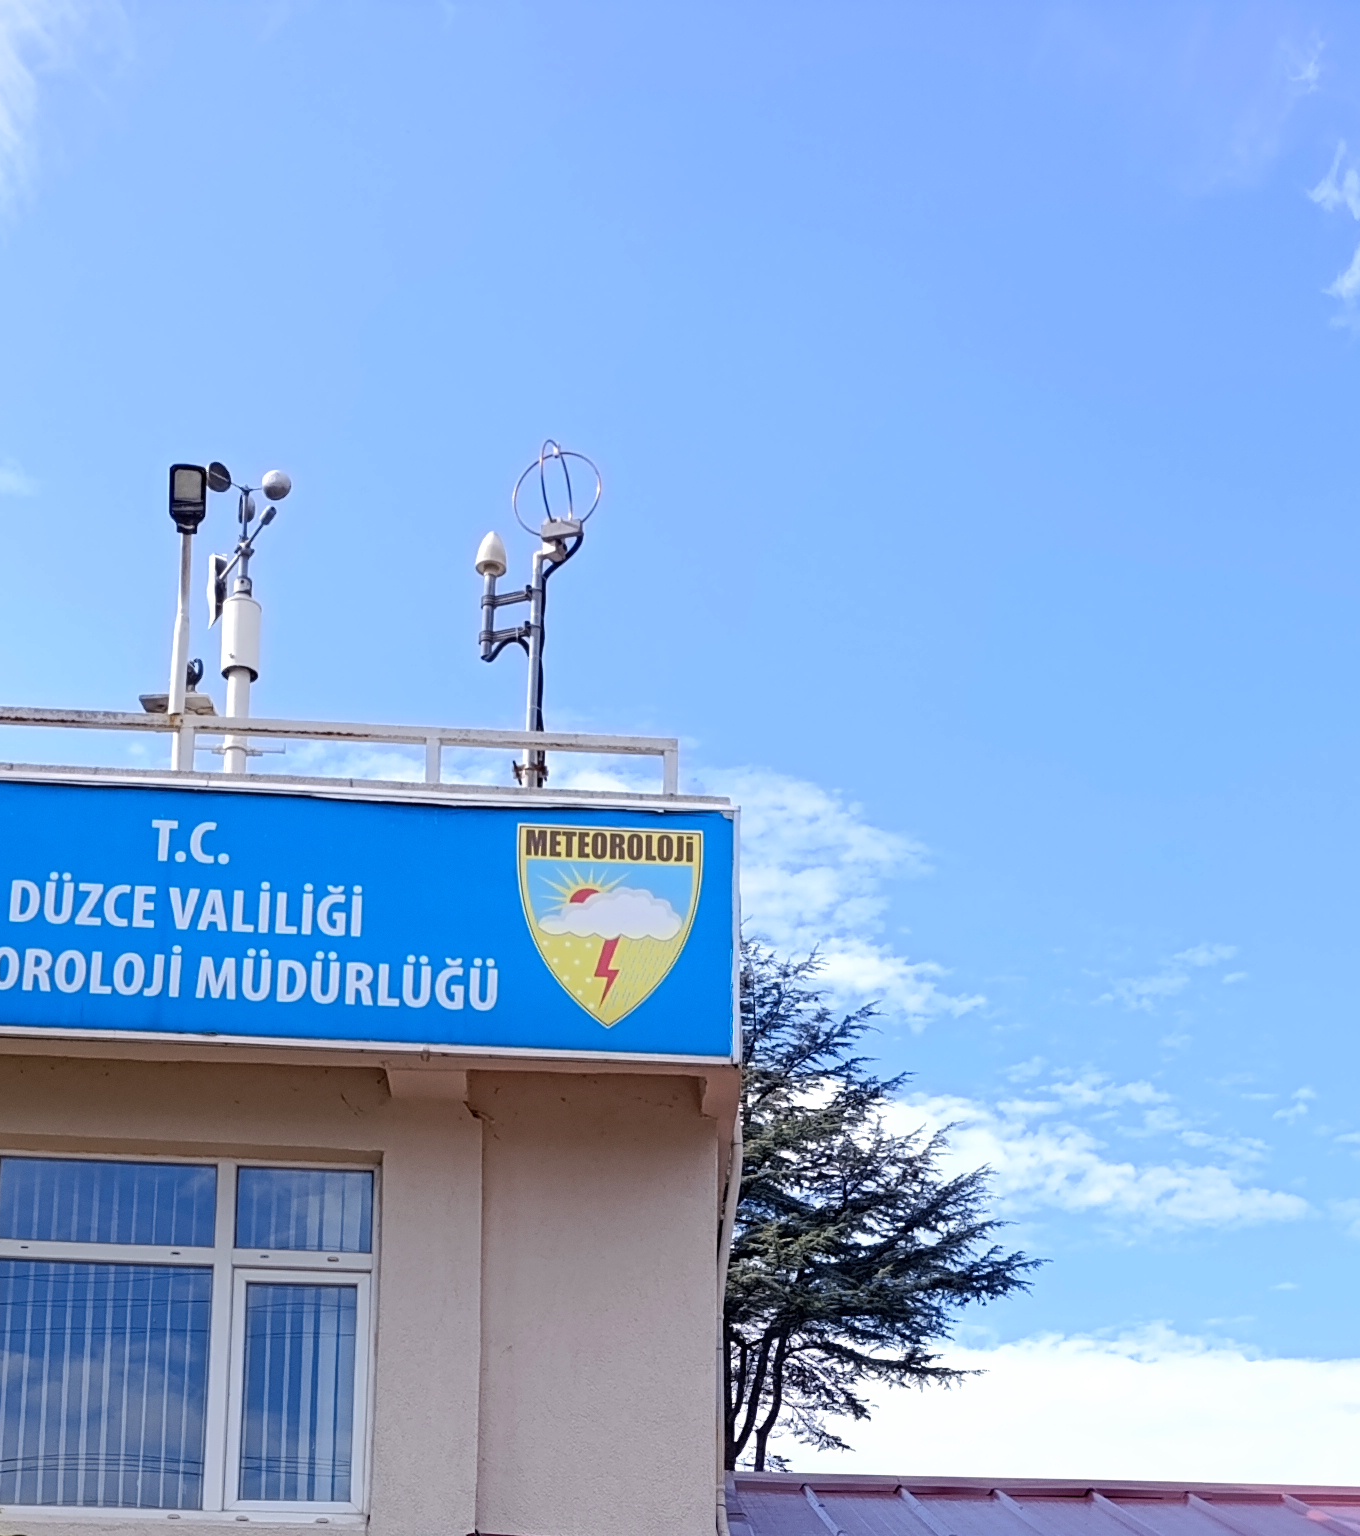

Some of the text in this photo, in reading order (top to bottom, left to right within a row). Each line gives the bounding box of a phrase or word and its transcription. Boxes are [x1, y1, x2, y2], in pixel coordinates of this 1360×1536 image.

[151, 819, 230, 865] T.C.
[9, 871, 363, 938] DÜZCE VALİLİĞİ
[195, 948, 498, 1011] MÜDÜRLÜĞÜ
